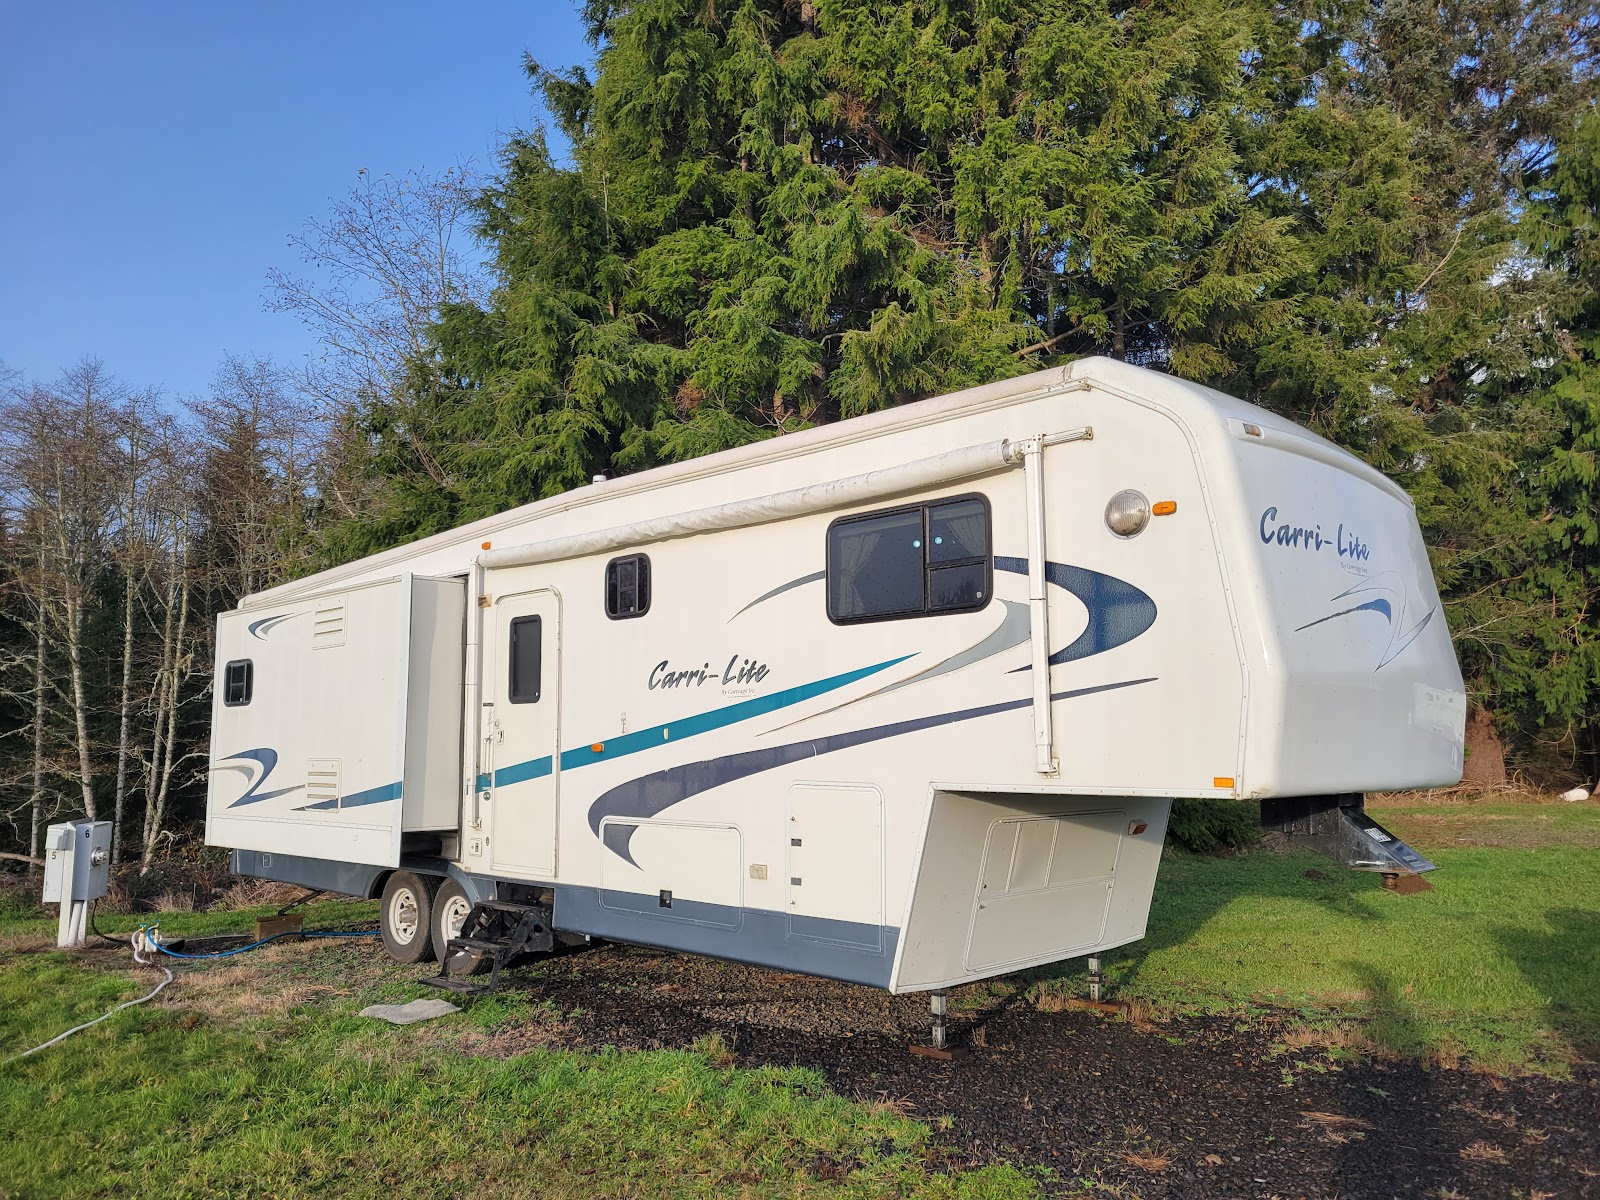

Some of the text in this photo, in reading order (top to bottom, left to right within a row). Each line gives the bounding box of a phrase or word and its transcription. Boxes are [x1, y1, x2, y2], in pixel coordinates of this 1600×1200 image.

[1260, 507, 1369, 561] Carri-Lite
[648, 654, 770, 690] Carri-Lite
[85, 829, 90, 838] 6
[51, 851, 57, 860] 5
